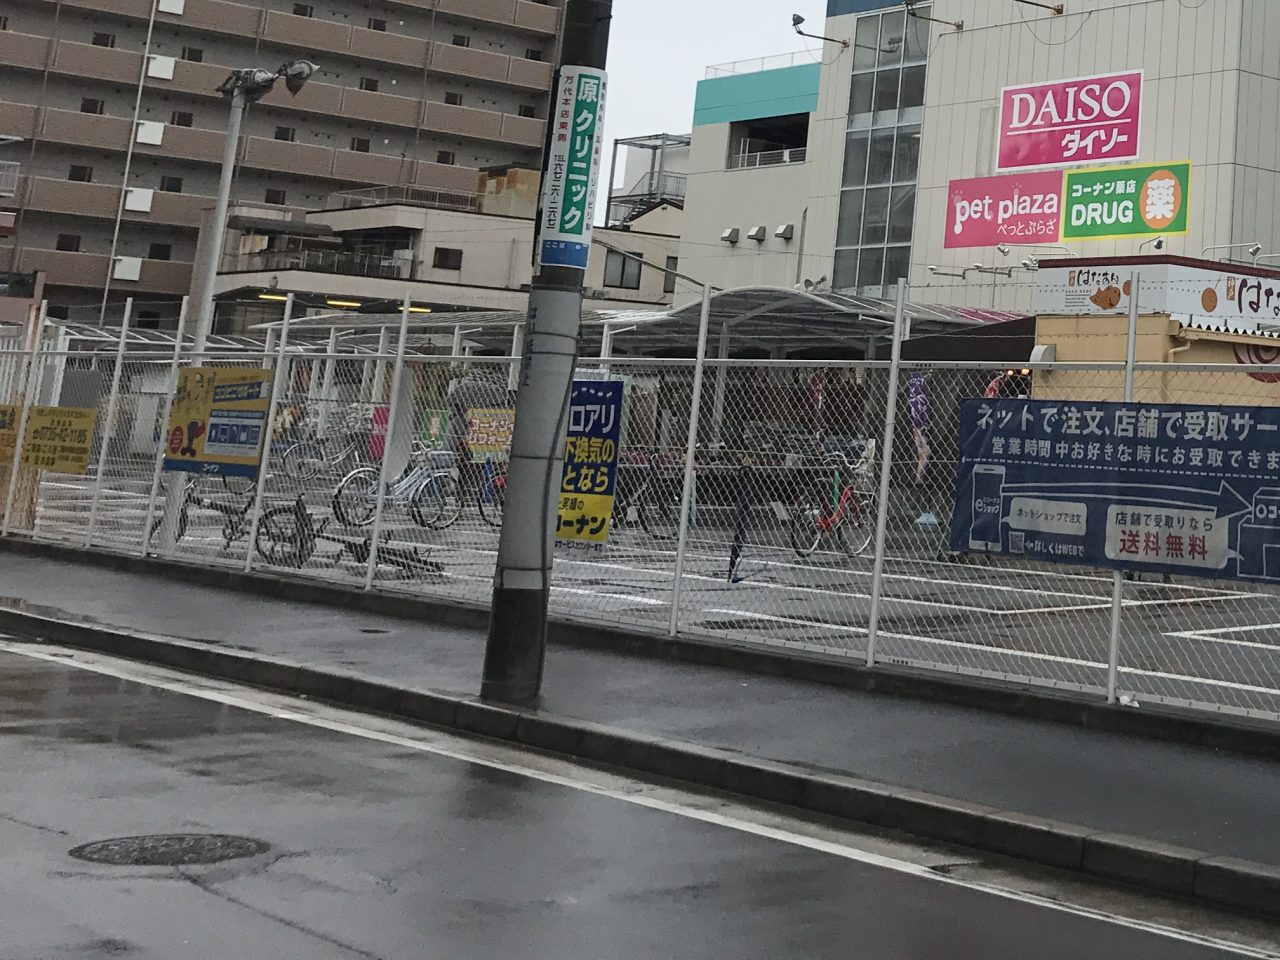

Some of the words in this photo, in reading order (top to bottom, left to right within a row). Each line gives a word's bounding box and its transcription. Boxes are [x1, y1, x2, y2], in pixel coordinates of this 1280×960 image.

[1009, 81, 1132, 129] DAISO
[1062, 128, 1128, 157] ダイソー
[1071, 180, 1137, 197] コーナン薬店
[1145, 178, 1175, 220] 薬
[953, 195, 993, 235] pet
[997, 193, 1059, 225] plaza
[997, 219, 1057, 235] ぺっとぷらざ
[1071, 200, 1134, 226] DRUG
[1115, 512, 1213, 532] 店舗で受取りなら
[1119, 529, 1209, 561] 送料無料
